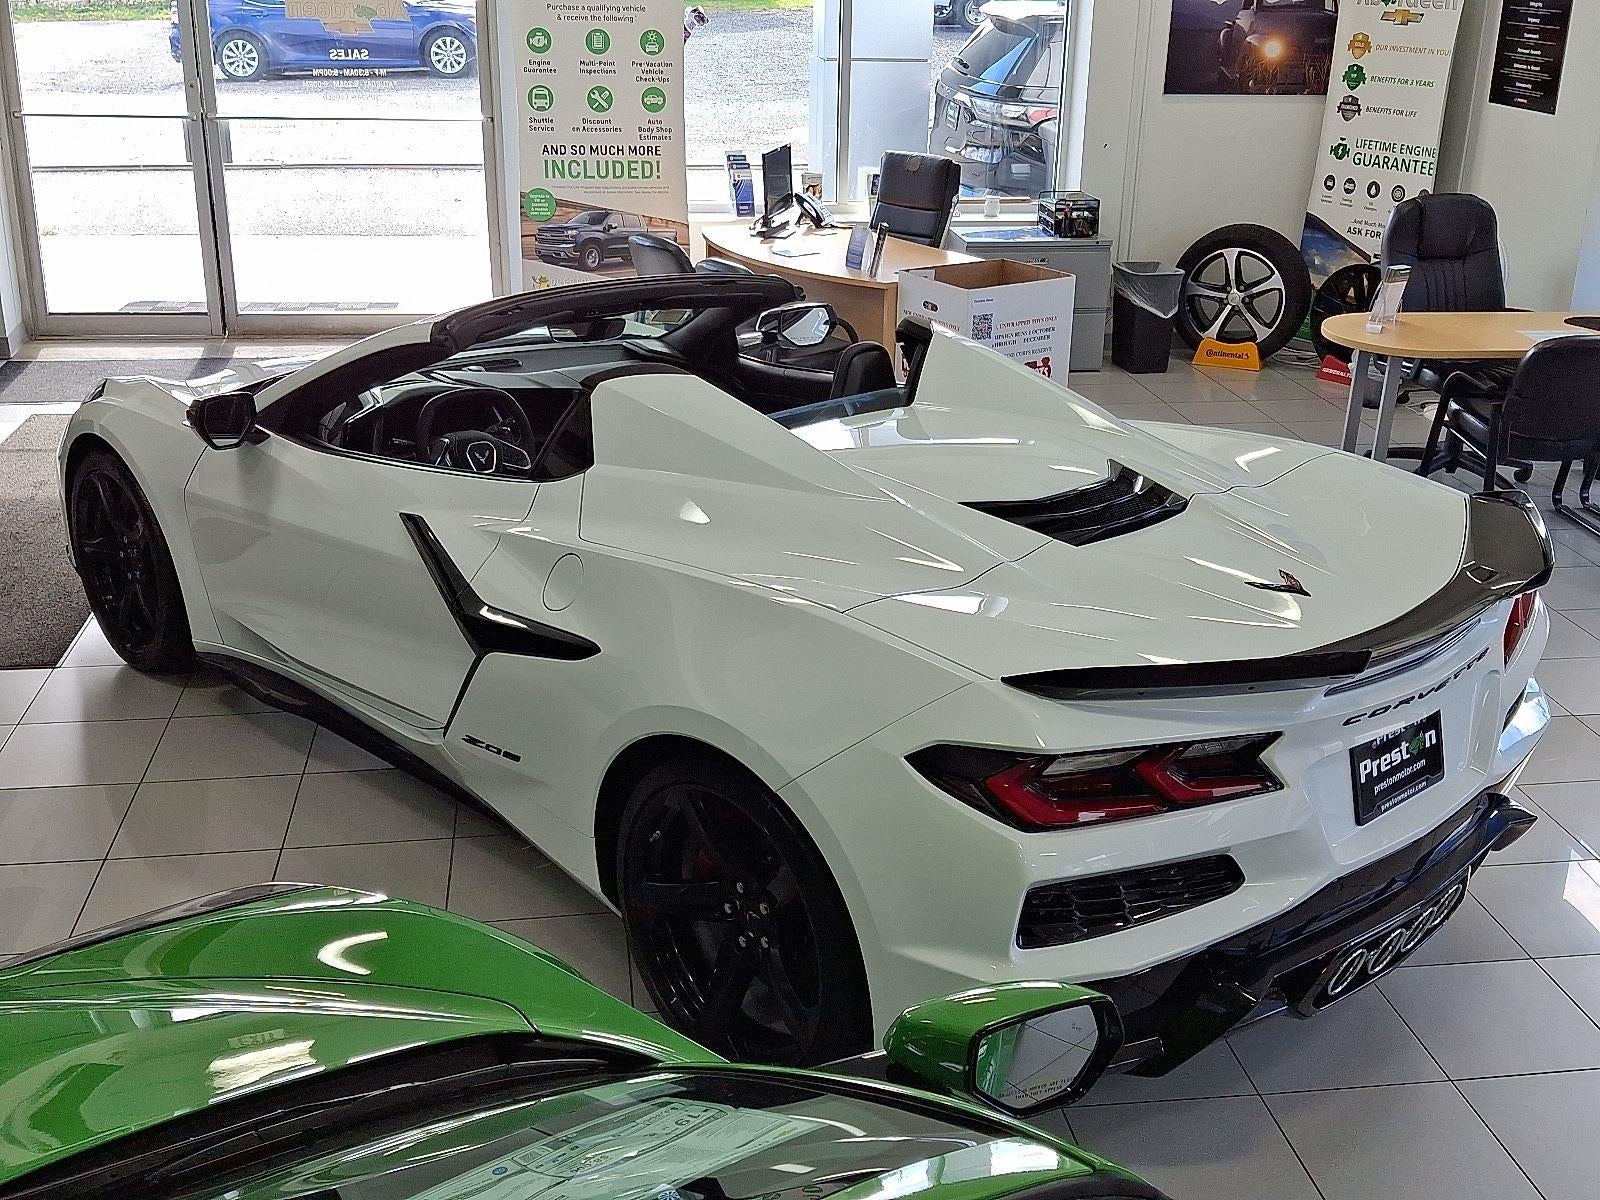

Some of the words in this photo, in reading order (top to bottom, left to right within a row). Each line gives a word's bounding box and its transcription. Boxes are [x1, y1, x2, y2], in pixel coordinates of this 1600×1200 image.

[586, 4, 621, 13] qualifying
[1389, 44, 1427, 54] INVESTMENT
[528, 59, 550, 67] Engine
[1370, 75, 1396, 84] BENEFITS
[1365, 106, 1392, 115] BENEFITS
[1392, 108, 1404, 116] FOR
[542, 145, 566, 156] AND
[570, 145, 586, 156] SO
[590, 145, 624, 156] MUCH
[628, 146, 661, 156] MORE
[1356, 138, 1397, 153] LIFETIME
[1400, 144, 1436, 158] ENGINE
[1353, 152, 1434, 176] GUARANTEE
[544, 159, 661, 180] INCLUDED!
[1347, 226, 1362, 236] ASK
[1365, 230, 1381, 239] FOR
[1000, 320, 1030, 329] UNWRAPPED
[1023, 335, 1050, 343] DECEMBER
[1032, 346, 1052, 354] RESERVE
[1206, 349, 1244, 359] Continental
[1342, 647, 1489, 726] CORVETTE
[1374, 759, 1426, 796] prestonmotor.com
[1381, 781, 1426, 812] prestonmotor.com
